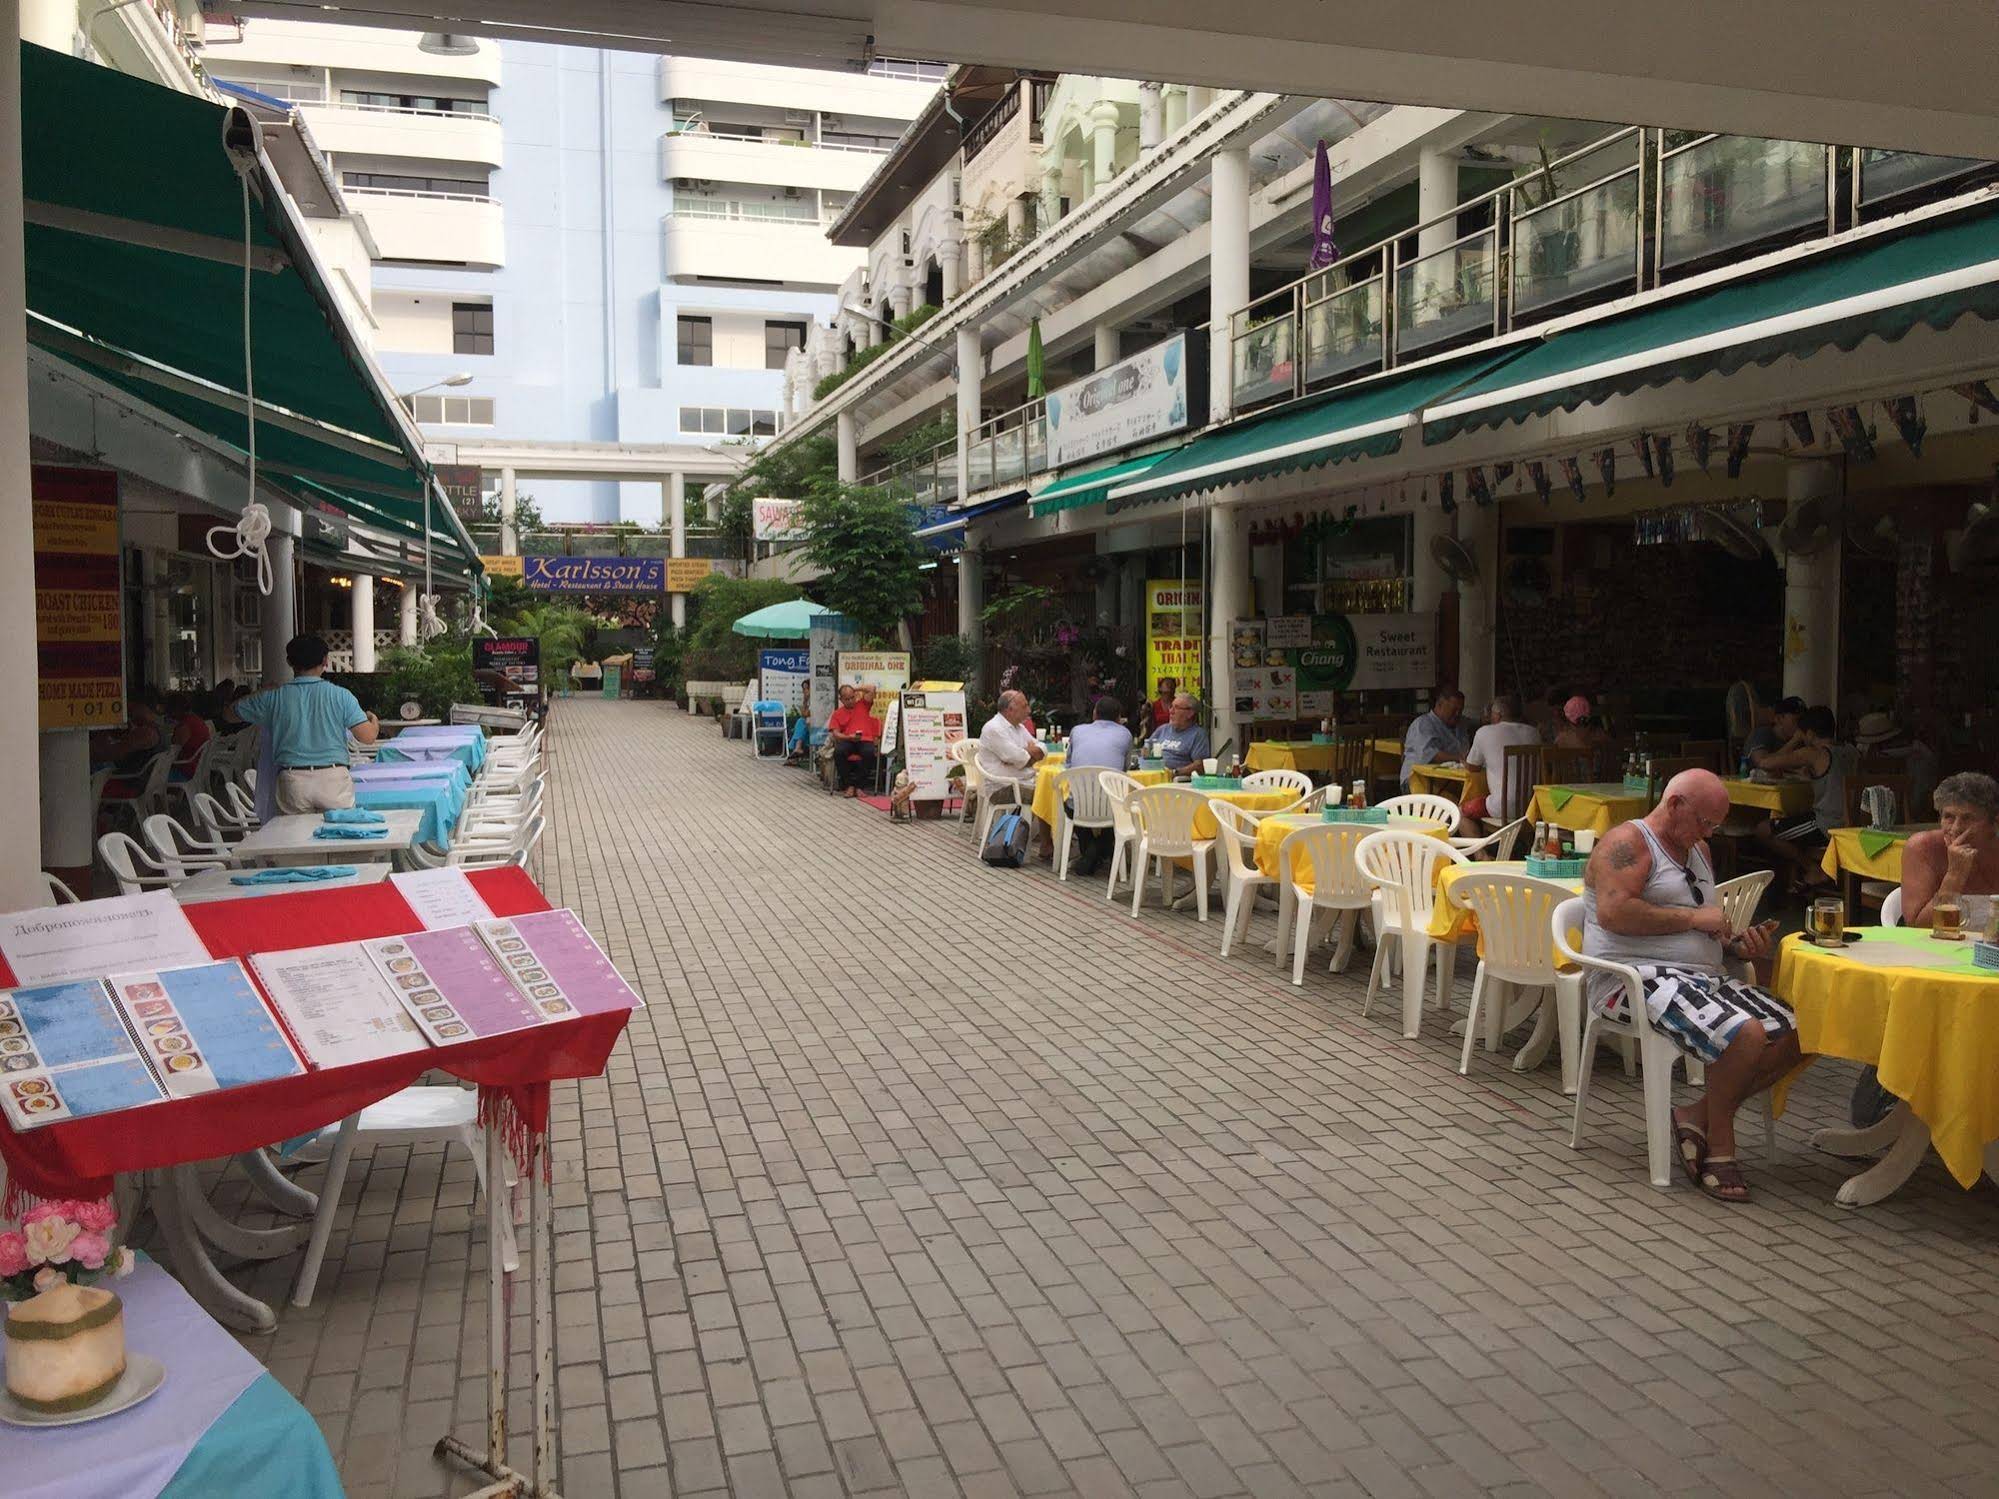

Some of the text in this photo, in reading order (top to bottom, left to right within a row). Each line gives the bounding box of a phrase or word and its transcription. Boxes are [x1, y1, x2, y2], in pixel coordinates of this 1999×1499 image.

[526, 558, 659, 580] Karlsson's
[37, 591, 119, 611] ROAST CHICKEN
[1156, 591, 1201, 606] ORIGIN
[1379, 630, 1417, 643] Sweet
[1366, 645, 1427, 657] Restaurant
[764, 655, 796, 670] Tong
[844, 661, 905, 671] ORIGINAL ONE
[1300, 651, 1345, 667] Chang
